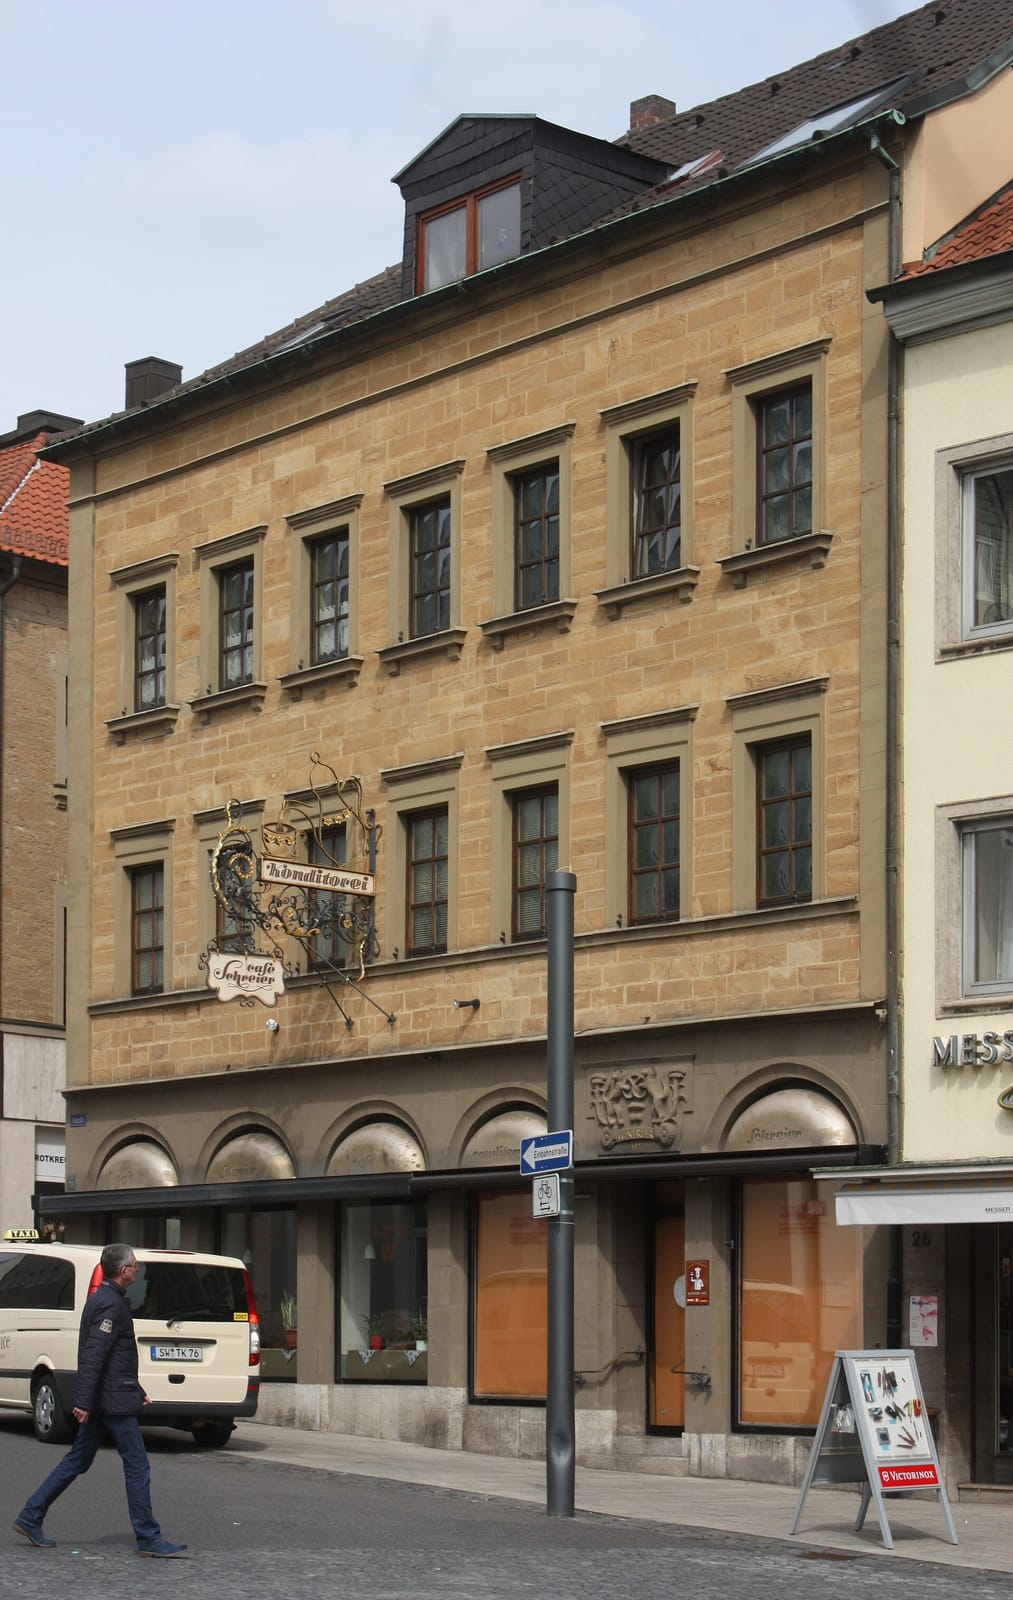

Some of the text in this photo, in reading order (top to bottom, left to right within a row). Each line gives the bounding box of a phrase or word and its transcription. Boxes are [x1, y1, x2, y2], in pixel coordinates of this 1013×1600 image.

[266, 862, 369, 891] Konditorei
[213, 960, 276, 986] Schreier
[35, 1154, 66, 1163] ROTKRE
[533, 1145, 568, 1159] Einbahnstraße
[11, 1230, 36, 1238] TAXI
[912, 1231, 931, 1247] 26
[159, 1349, 199, 1357] SW TK 76
